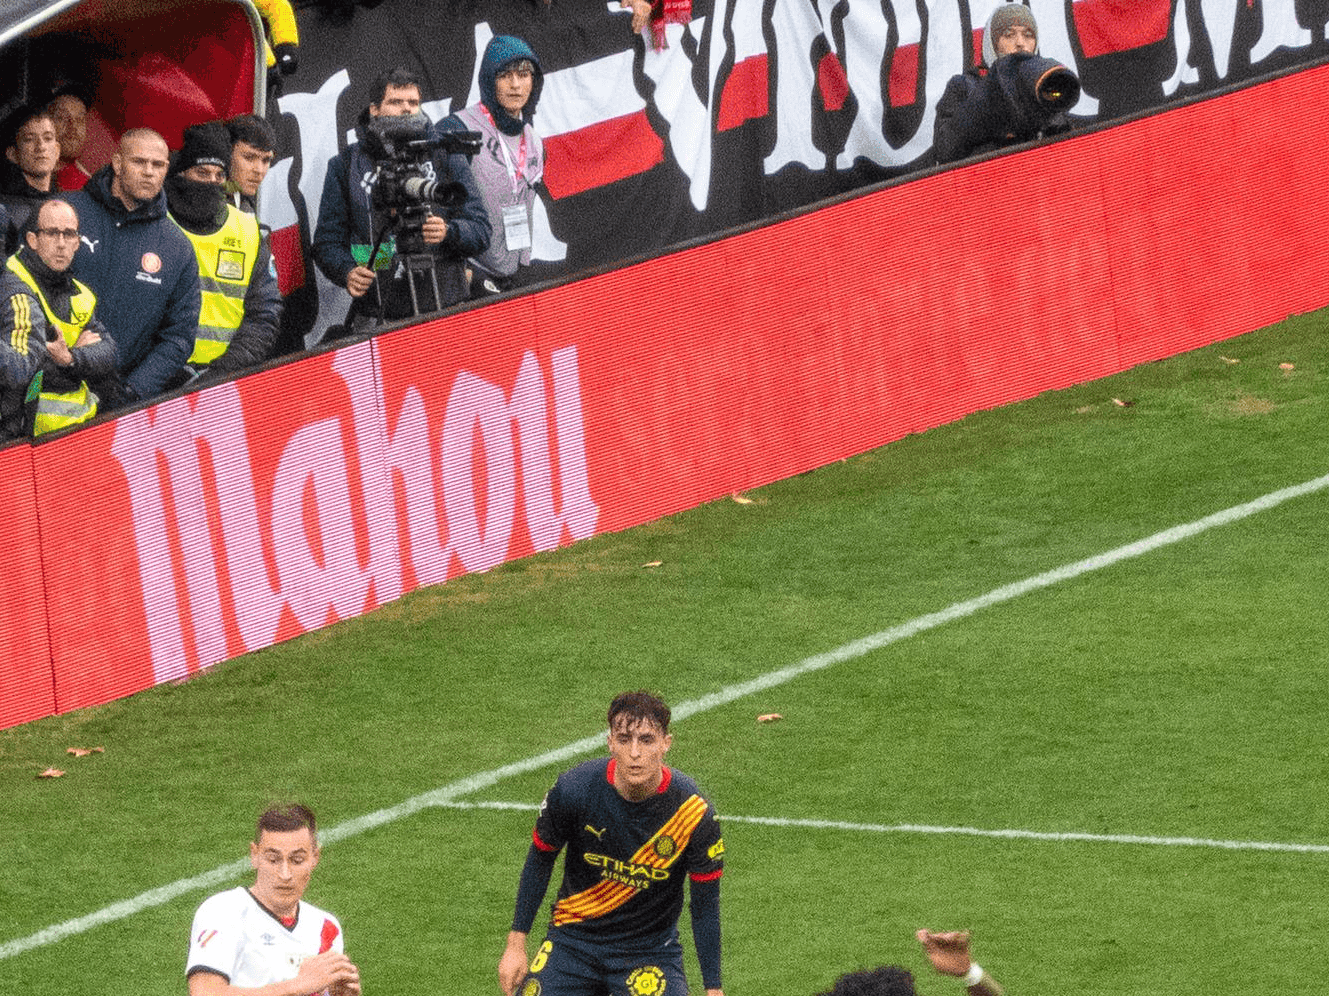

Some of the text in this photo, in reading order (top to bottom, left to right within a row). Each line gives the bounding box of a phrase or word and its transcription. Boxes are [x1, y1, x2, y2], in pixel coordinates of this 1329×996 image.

[112, 337, 599, 682] Mahou
[583, 852, 670, 881] ETIHAD
[600, 869, 650, 890] AIRWAYS
[529, 940, 554, 973] 6
